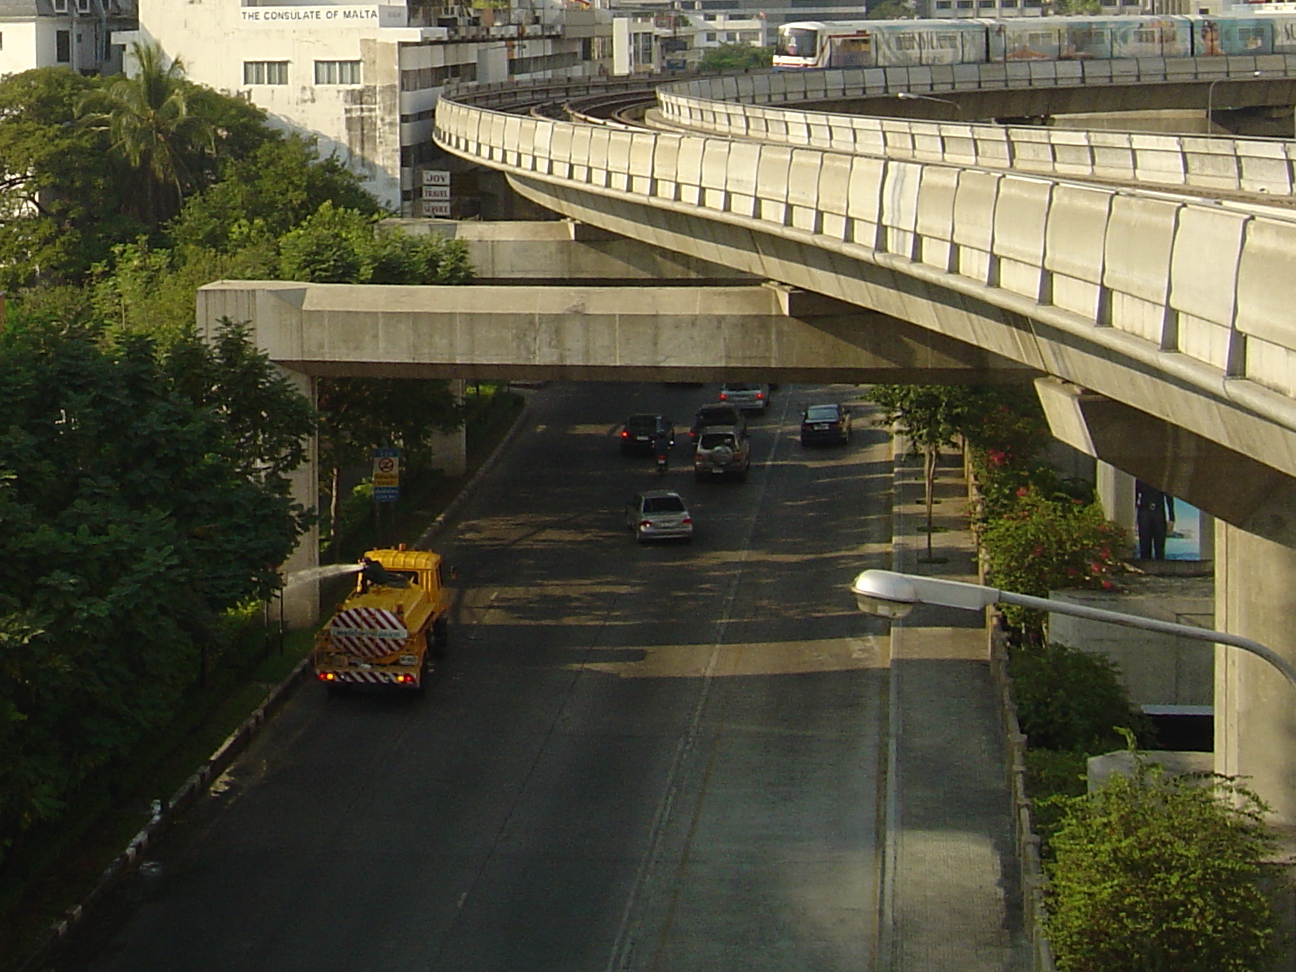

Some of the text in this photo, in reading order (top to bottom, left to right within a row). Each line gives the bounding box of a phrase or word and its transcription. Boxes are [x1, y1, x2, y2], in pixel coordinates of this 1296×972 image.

[241, 11, 260, 21] THE
[263, 10, 322, 21] CONSULATE
[325, 10, 339, 20] OF
[343, 9, 378, 20] MALTA
[426, 174, 446, 183] JOY
